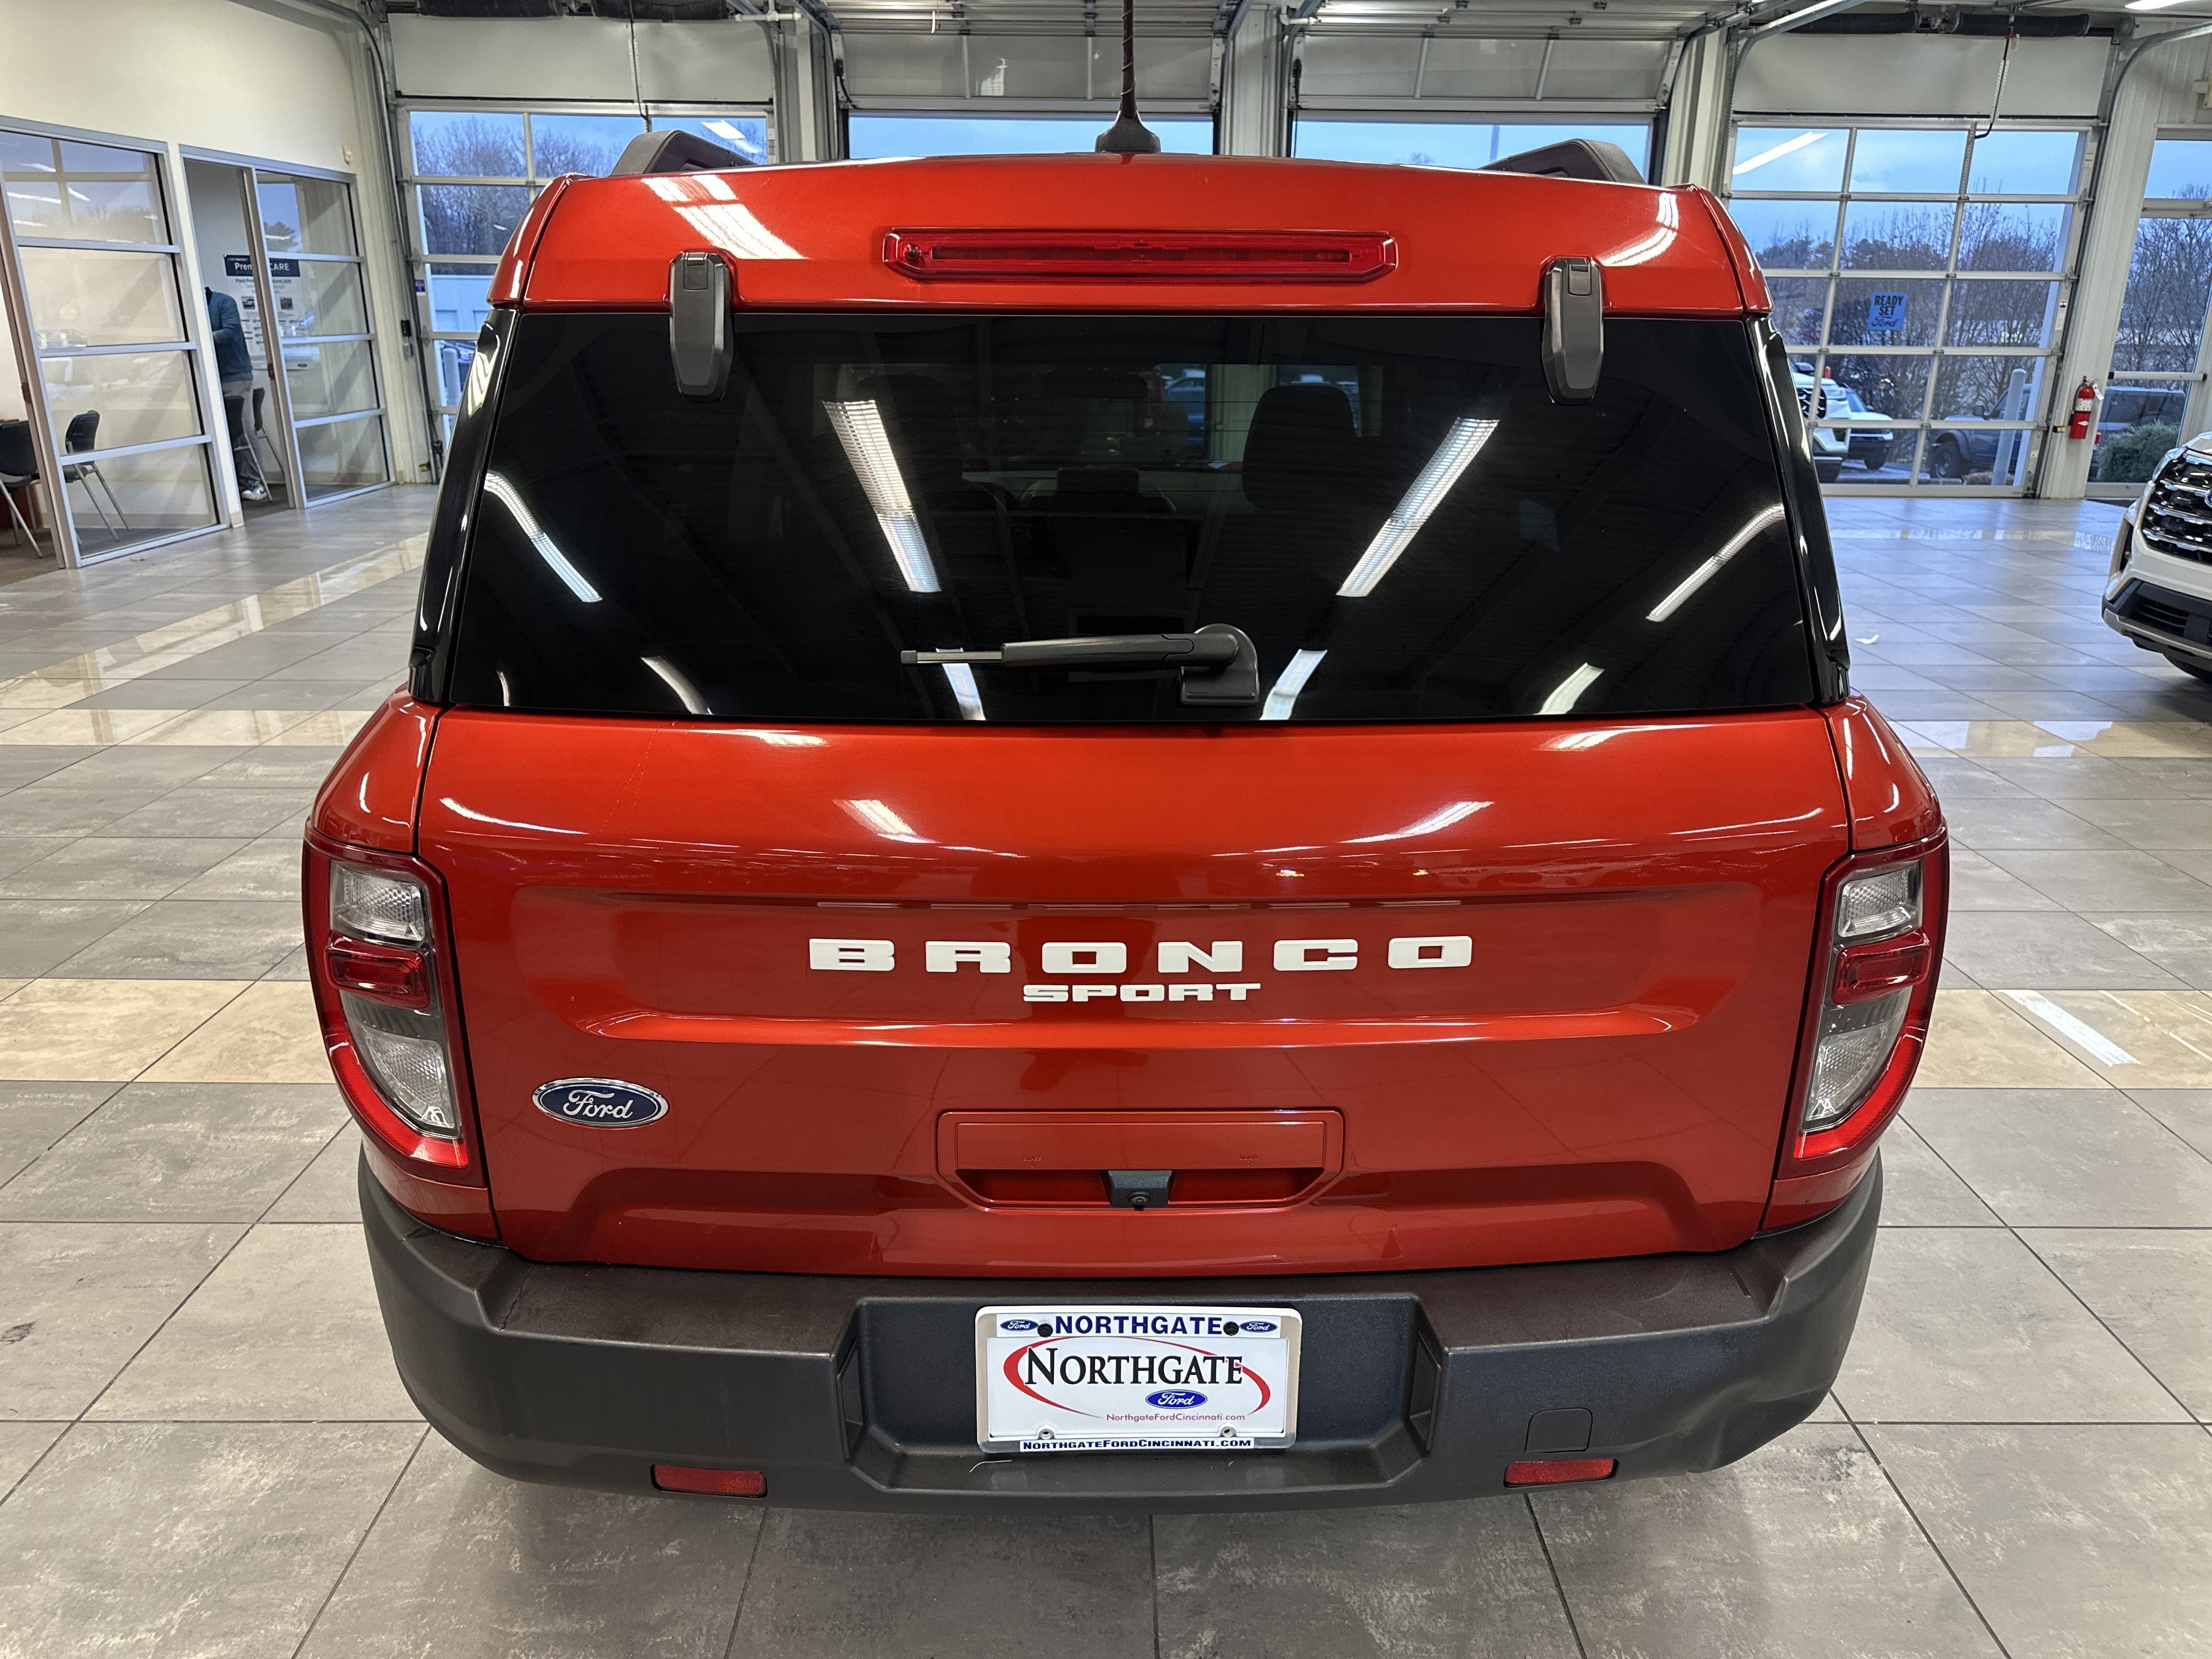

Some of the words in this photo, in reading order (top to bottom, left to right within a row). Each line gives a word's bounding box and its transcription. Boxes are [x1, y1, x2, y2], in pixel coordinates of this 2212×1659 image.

[1874, 295, 1904, 306] READY
[1878, 306, 1895, 315] SET
[809, 936, 1472, 973] BRONCO
[1023, 983, 1261, 1002] SPORT
[563, 1090, 634, 1119] Ford
[1007, 1321, 1030, 1329] Ford
[1056, 1315, 1222, 1334] NORTHGATE
[1246, 1321, 1270, 1331] Ford
[1158, 1392, 1195, 1406] Ford
[1107, 1413, 1245, 1423] NorthgateFordCincinnati.com
